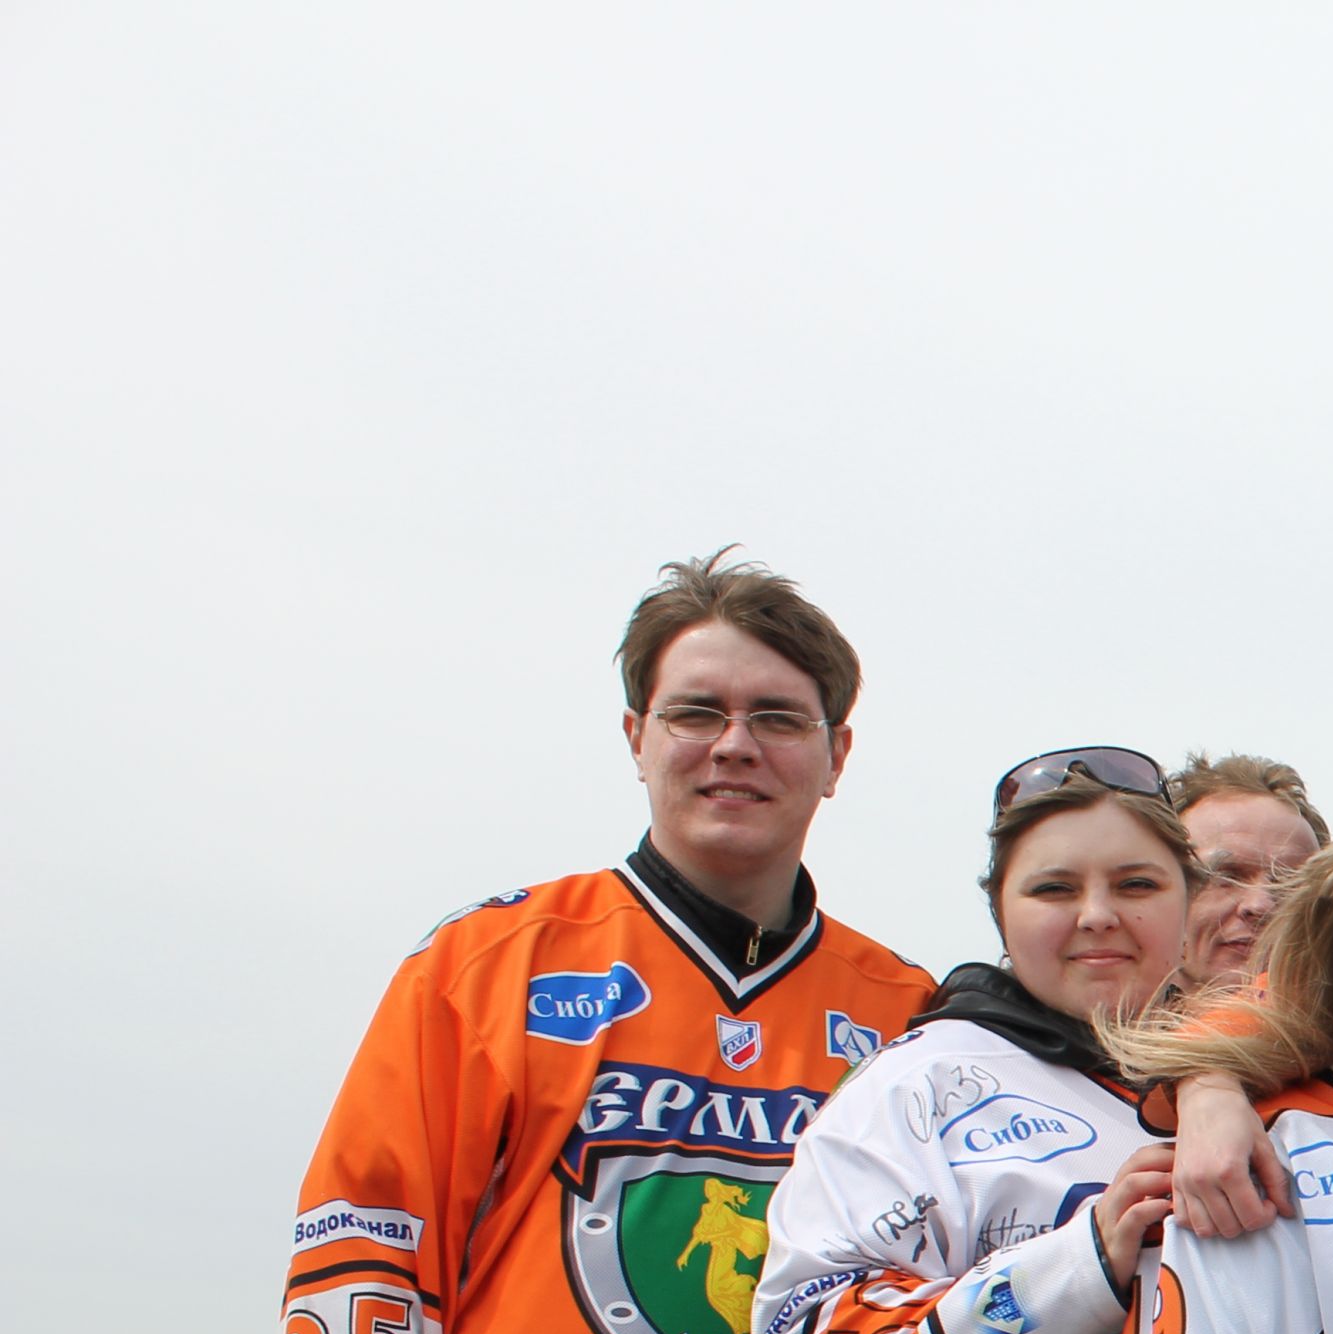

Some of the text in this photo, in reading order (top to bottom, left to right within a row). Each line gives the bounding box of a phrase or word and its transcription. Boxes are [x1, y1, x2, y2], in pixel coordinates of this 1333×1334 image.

[724, 1033, 750, 1055] ВХЛ
[576, 1070, 824, 1145] ЕРМА
[964, 1113, 1068, 1152] Сибна
[294, 1211, 414, 1245] Водоканал
